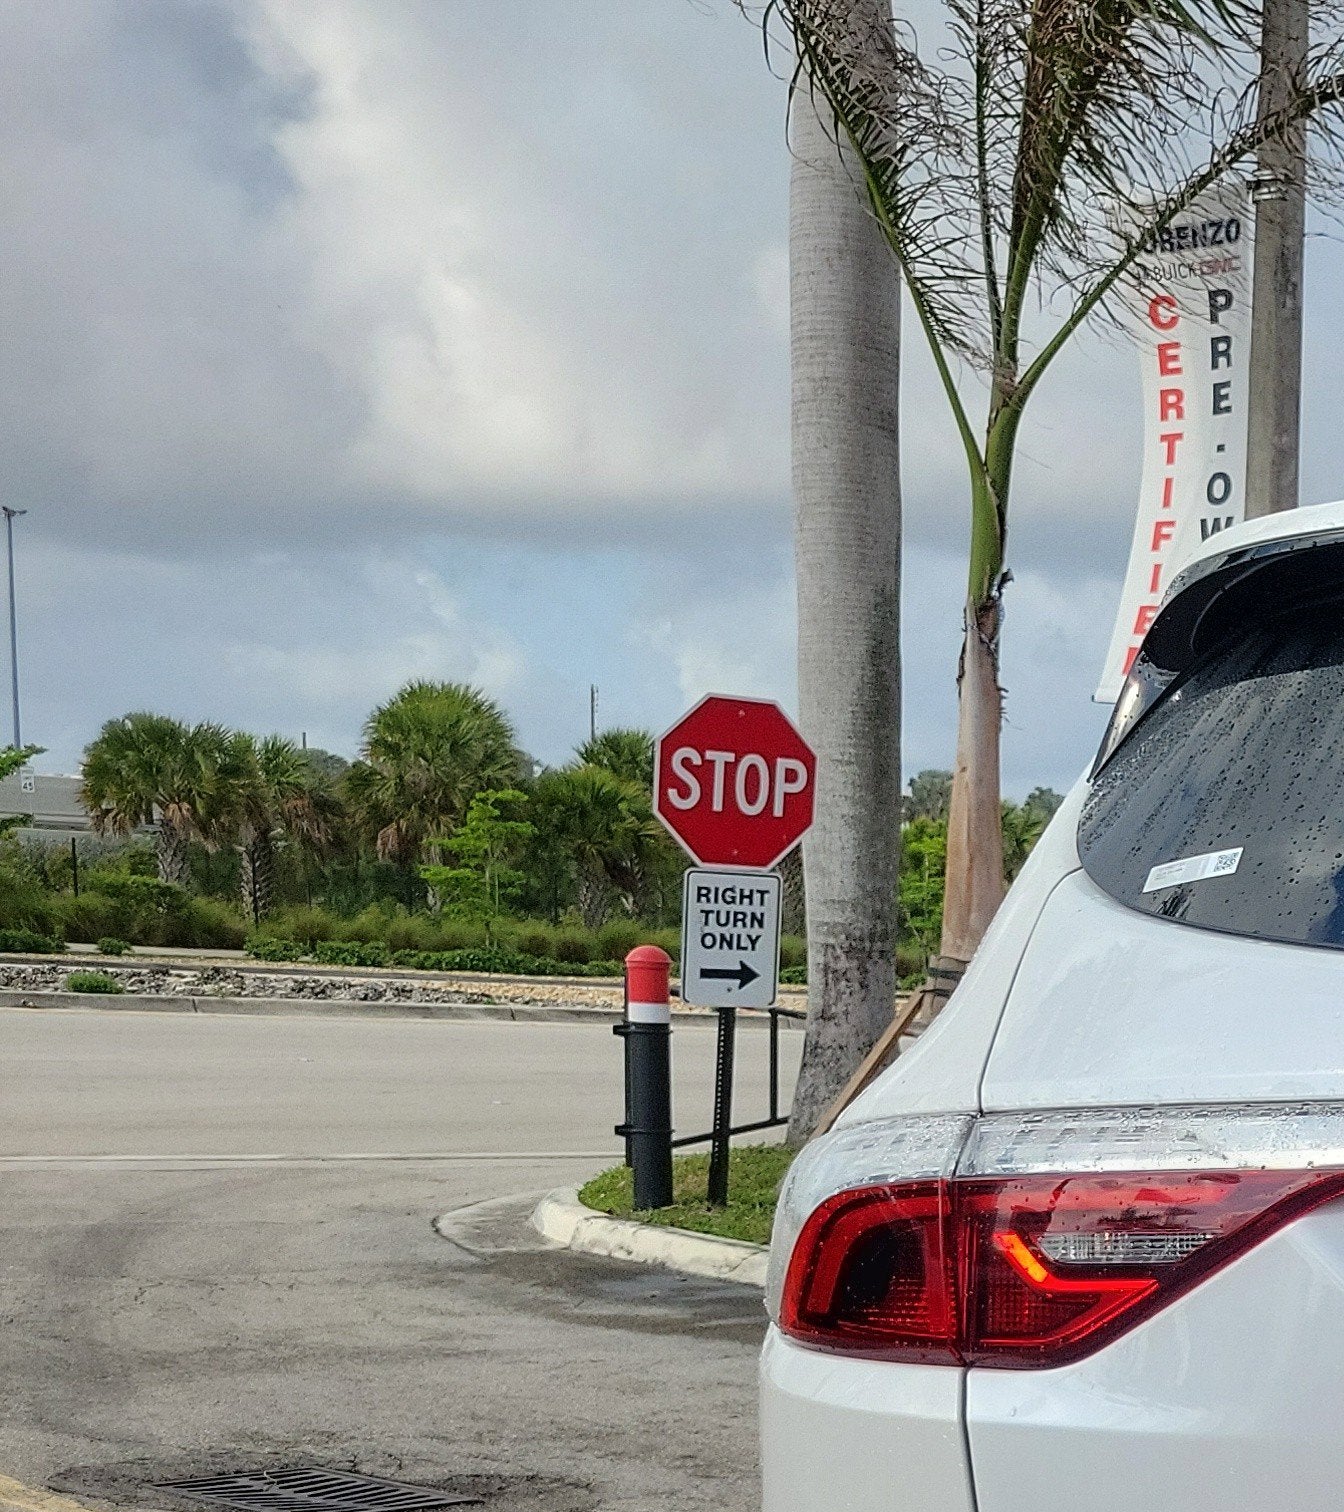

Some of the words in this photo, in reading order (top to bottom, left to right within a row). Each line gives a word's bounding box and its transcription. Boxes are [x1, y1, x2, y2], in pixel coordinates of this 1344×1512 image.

[667, 747, 808, 818] STOP
[696, 886, 770, 907] RIGHT
[700, 909, 765, 929] TURN
[701, 932, 762, 951] ONLY
